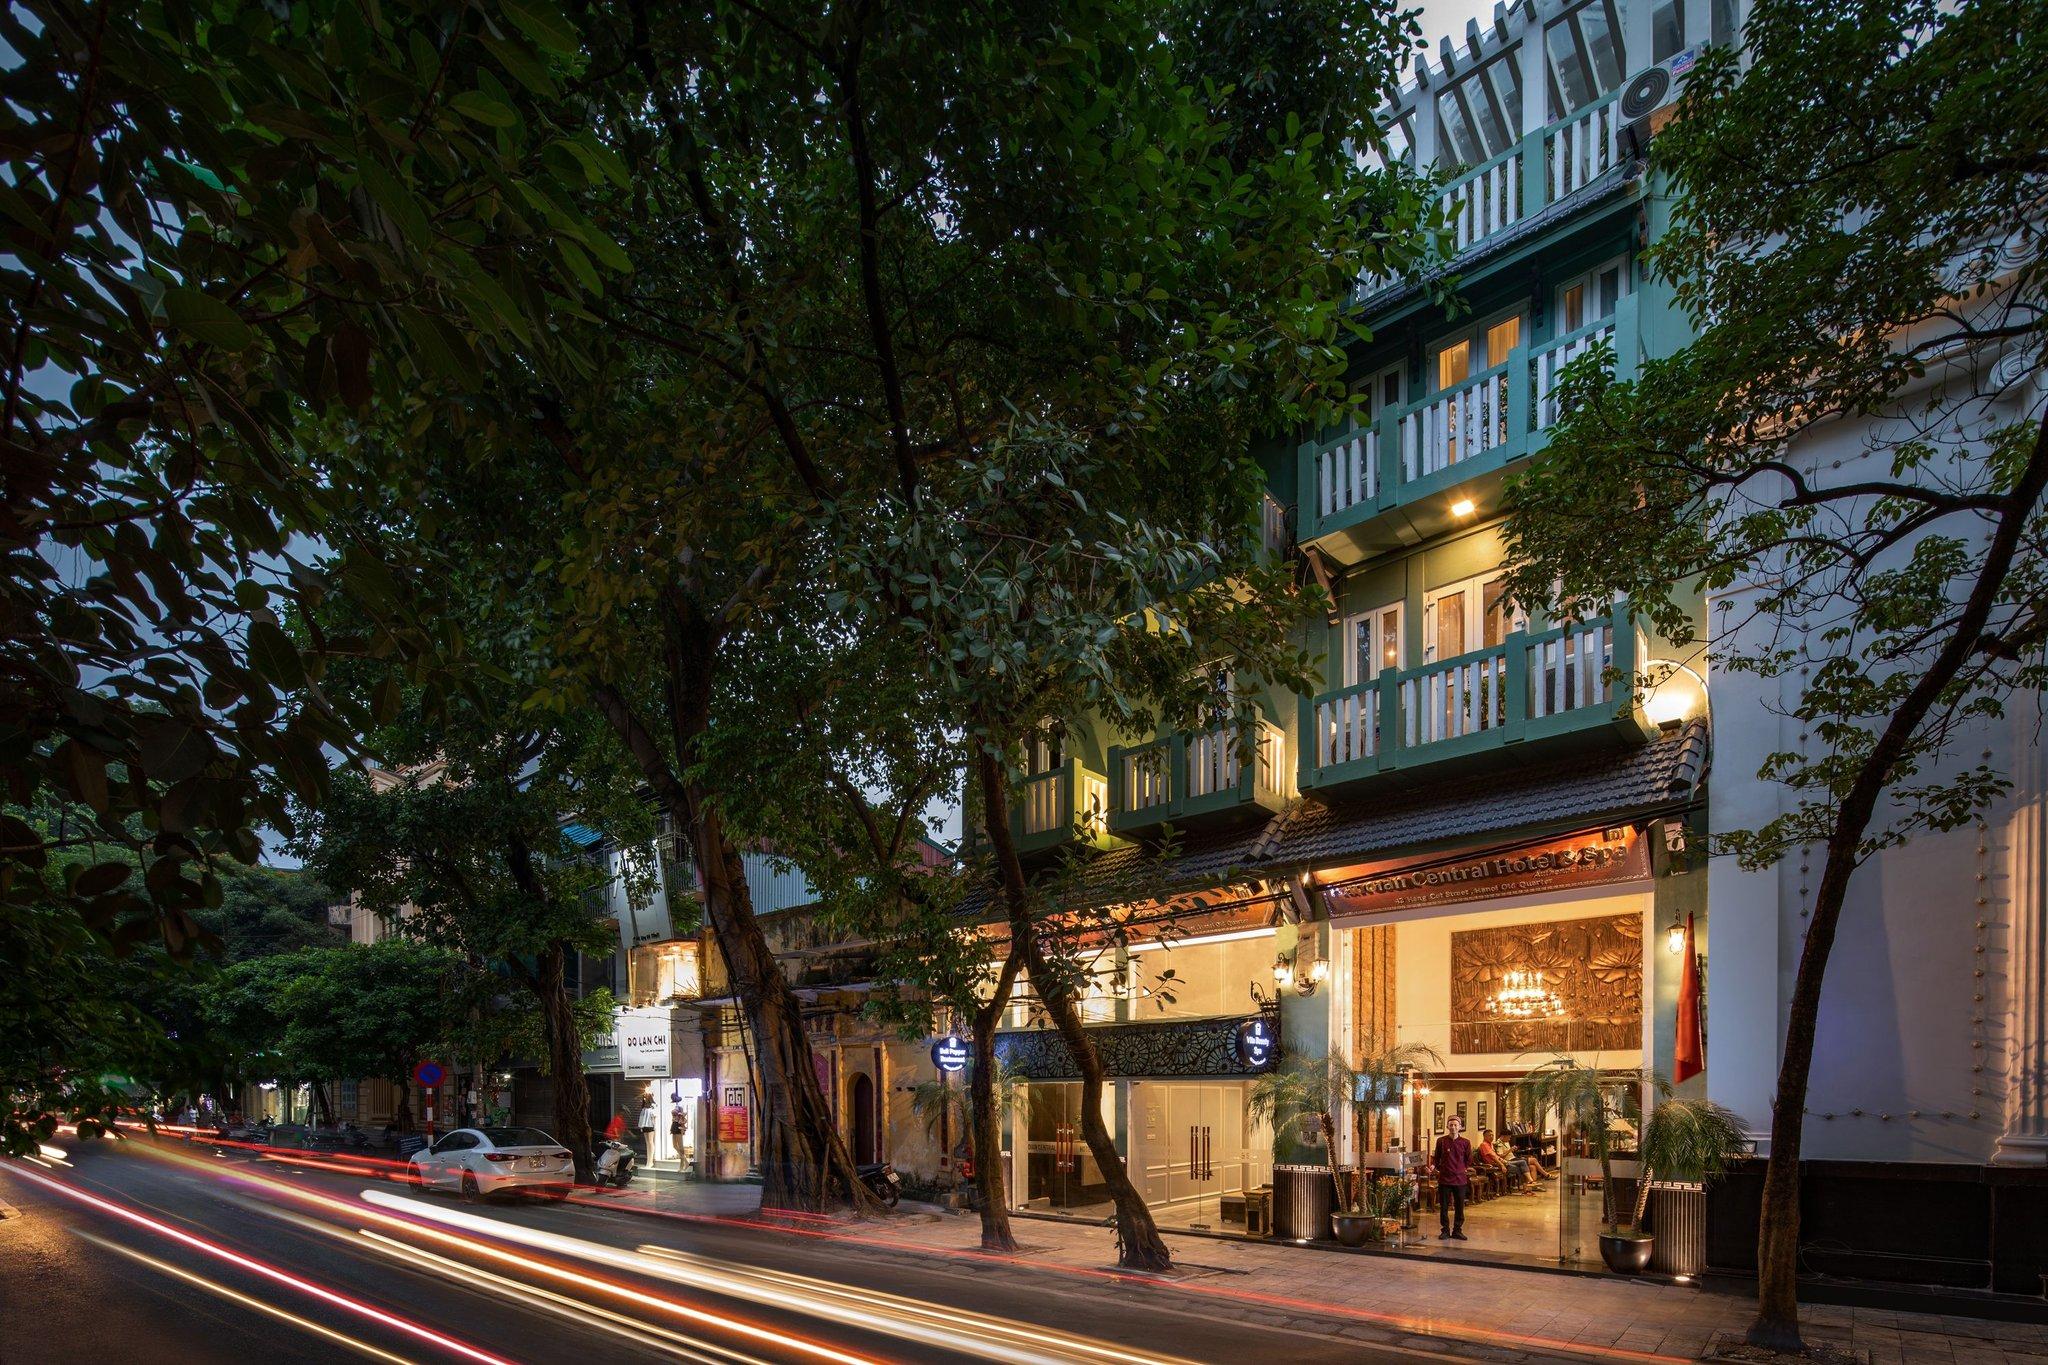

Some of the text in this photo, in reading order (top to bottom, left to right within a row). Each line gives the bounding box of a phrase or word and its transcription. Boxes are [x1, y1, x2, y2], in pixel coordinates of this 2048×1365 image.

[1411, 861, 1489, 887] Central
[1494, 852, 1557, 874] Hotel
[1583, 846, 1628, 863] Spa
[639, 1035, 653, 1047] LAN
[654, 1034, 667, 1046] CHI
